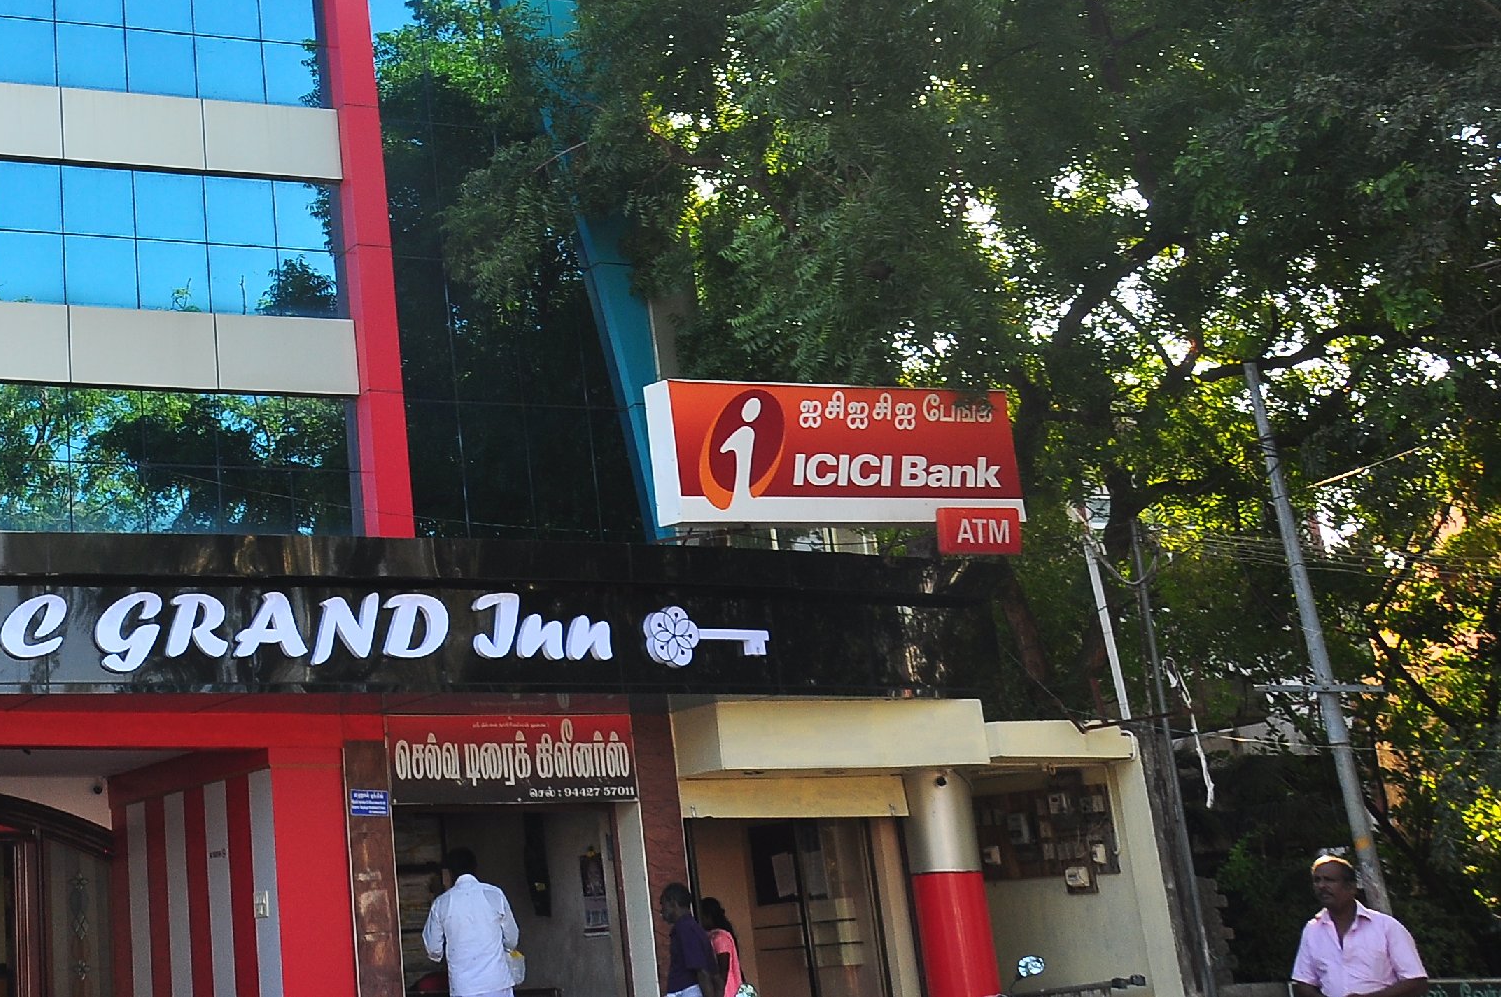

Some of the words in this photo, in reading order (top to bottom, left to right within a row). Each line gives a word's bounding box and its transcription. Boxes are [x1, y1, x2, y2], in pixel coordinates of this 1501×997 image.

[793, 453, 893, 487] ICICI
[900, 456, 1002, 488] Bank
[957, 518, 1010, 545] ATM
[94, 590, 450, 673] GRAND
[471, 592, 614, 661] Inn
[564, 787, 601, 797] 94427
[603, 786, 635, 796] 57011
